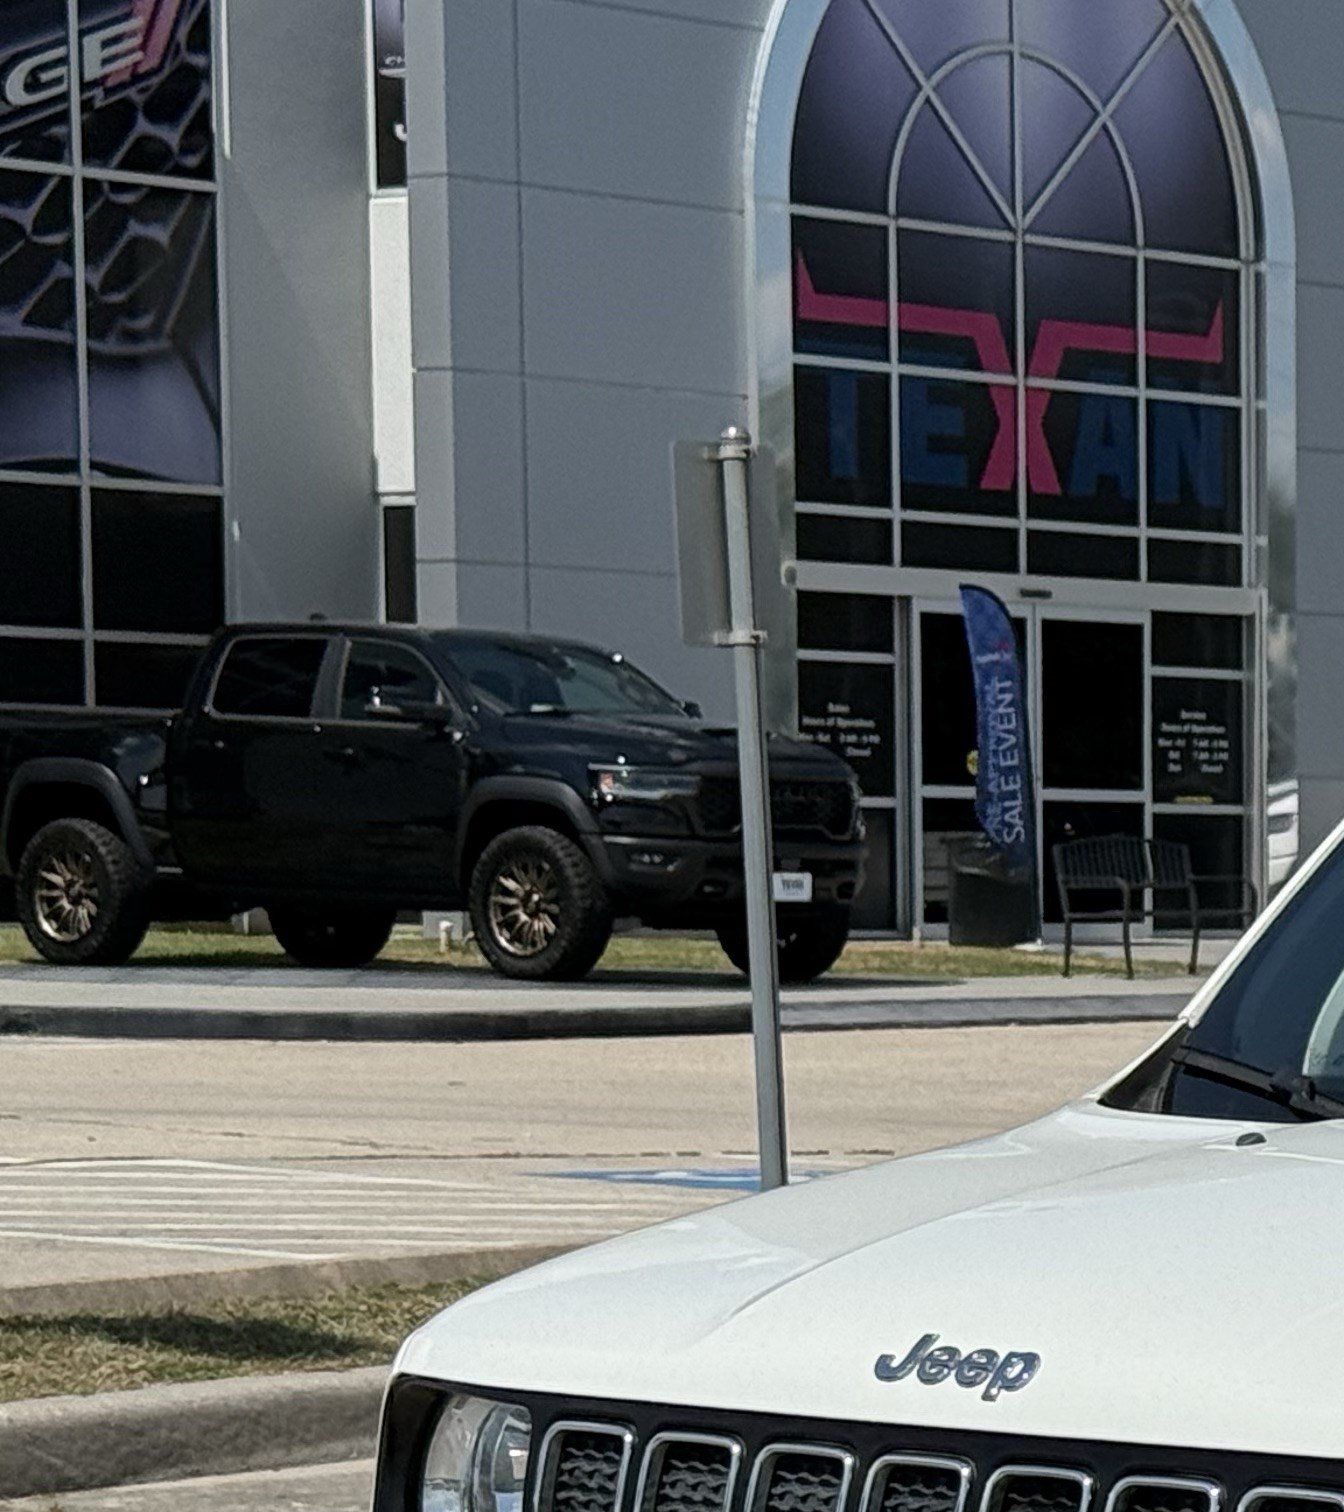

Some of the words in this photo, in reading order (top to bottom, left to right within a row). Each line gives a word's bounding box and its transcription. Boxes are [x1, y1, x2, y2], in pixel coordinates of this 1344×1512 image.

[798, 270, 1226, 511] TEXAN
[994, 677, 1020, 768] EVENT
[1000, 773, 1026, 844] SALE
[874, 1333, 1041, 1402] Jeep
